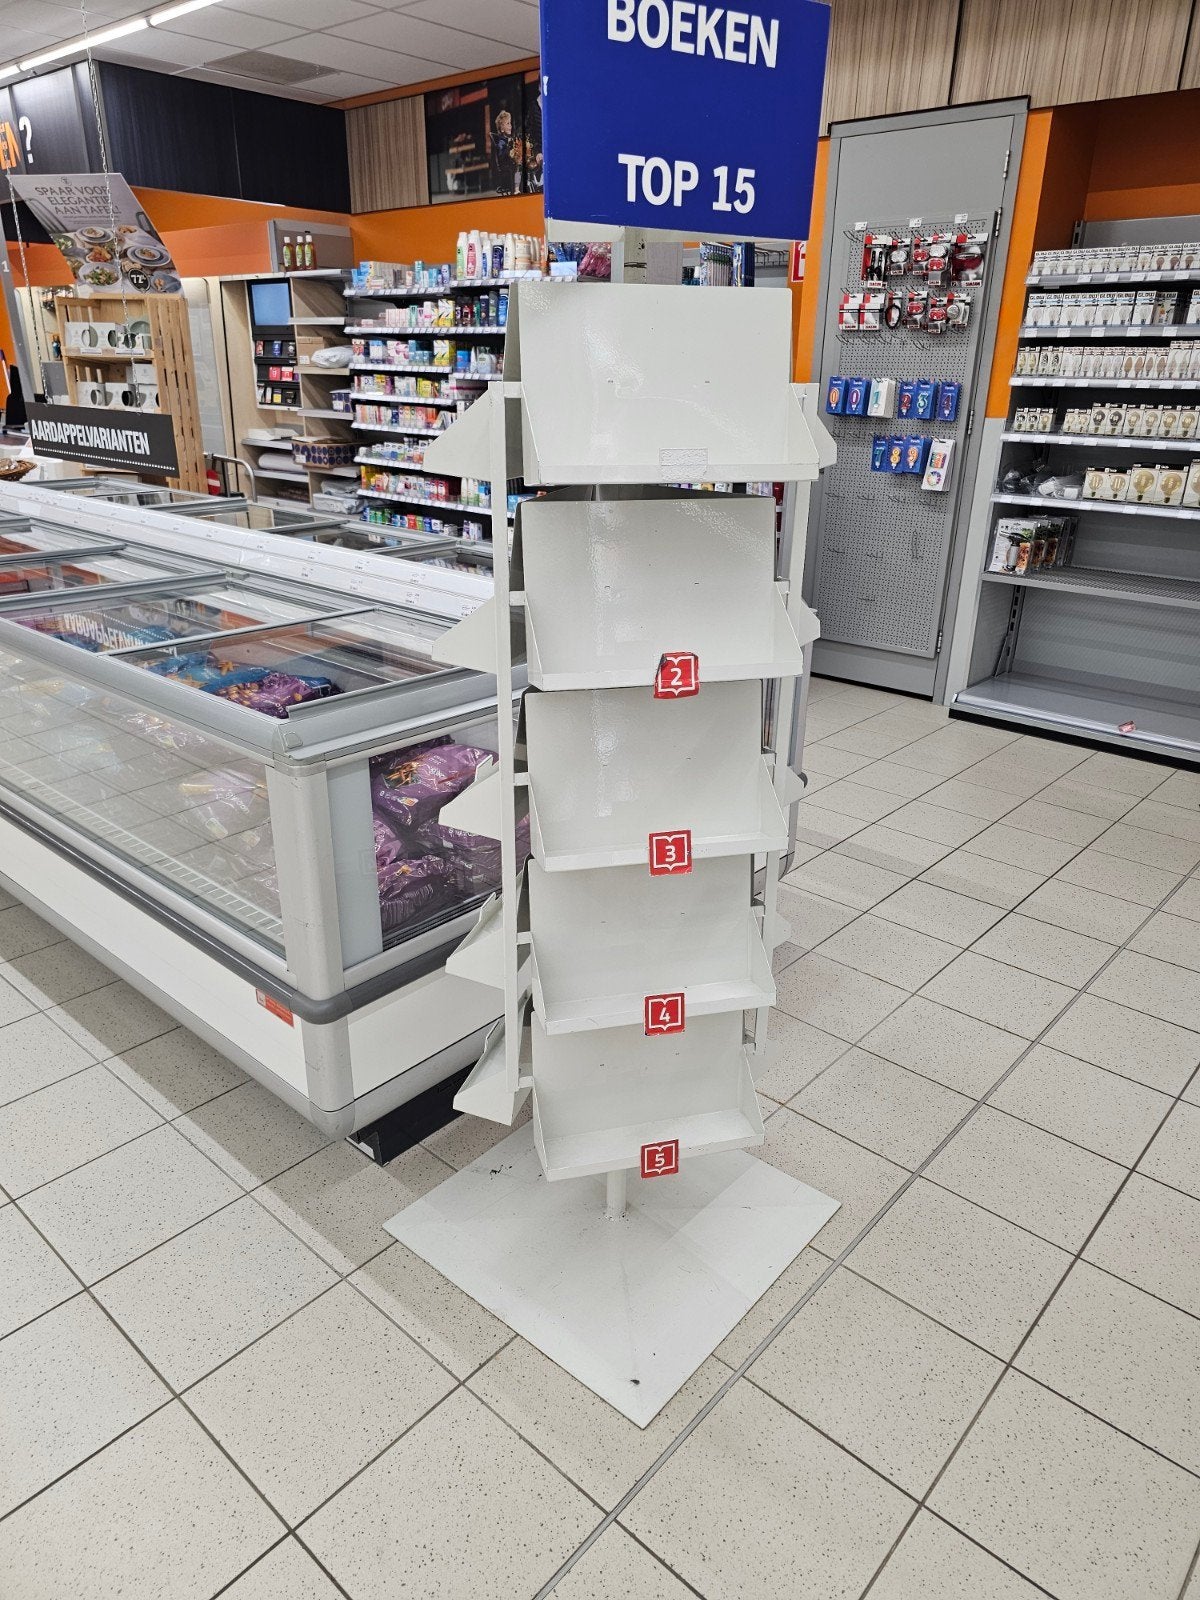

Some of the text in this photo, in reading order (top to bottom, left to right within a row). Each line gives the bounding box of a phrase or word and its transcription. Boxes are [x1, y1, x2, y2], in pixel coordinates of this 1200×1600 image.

[607, 0, 779, 69] BOEKEN
[34, 186, 76, 196] SPAAR
[617, 153, 756, 214] TOP 15
[54, 205, 82, 215] AAN
[31, 419, 151, 455] AARDAPPELVARIANTEN
[670, 667, 683, 686] 2
[664, 845, 676, 862] 3
[659, 1007, 670, 1023] 4
[654, 1153, 666, 1167] 5
